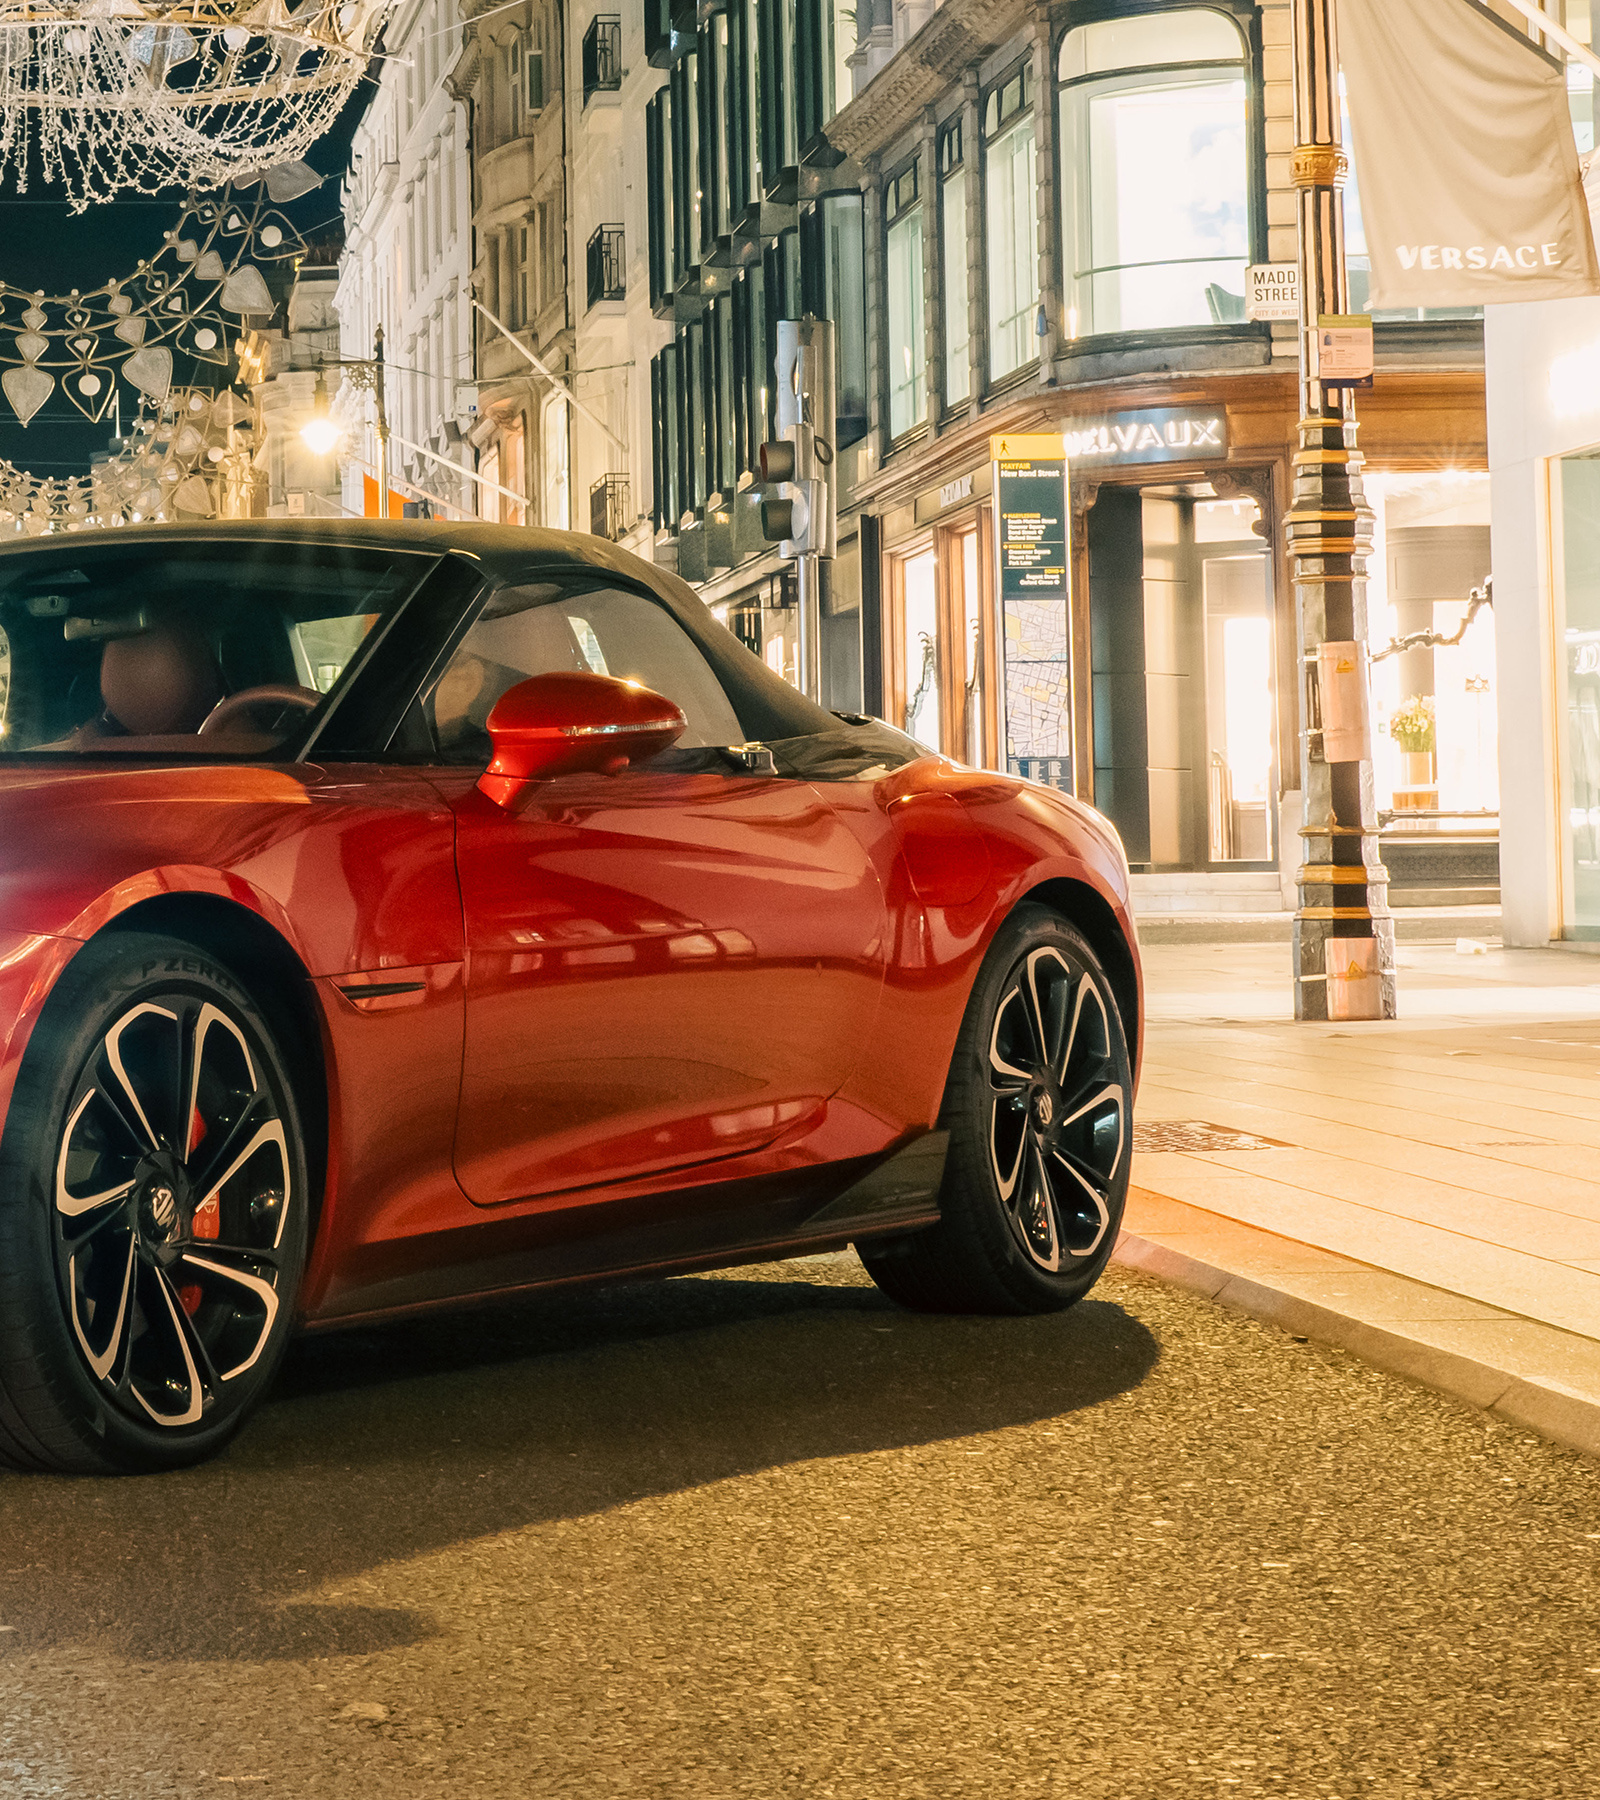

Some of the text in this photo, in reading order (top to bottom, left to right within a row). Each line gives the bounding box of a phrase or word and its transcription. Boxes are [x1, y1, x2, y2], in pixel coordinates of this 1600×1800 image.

[1395, 242, 1561, 270] VERSACE
[1253, 271, 1296, 285] MADD
[1254, 287, 1298, 302] STREE
[1254, 308, 1298, 317] CITY OF WEST
[1000, 462, 1031, 470] MAYFAIR
[1018, 469, 1037, 477] Bond
[1037, 469, 1060, 477] Street
[141, 958, 234, 991] P ZERO
